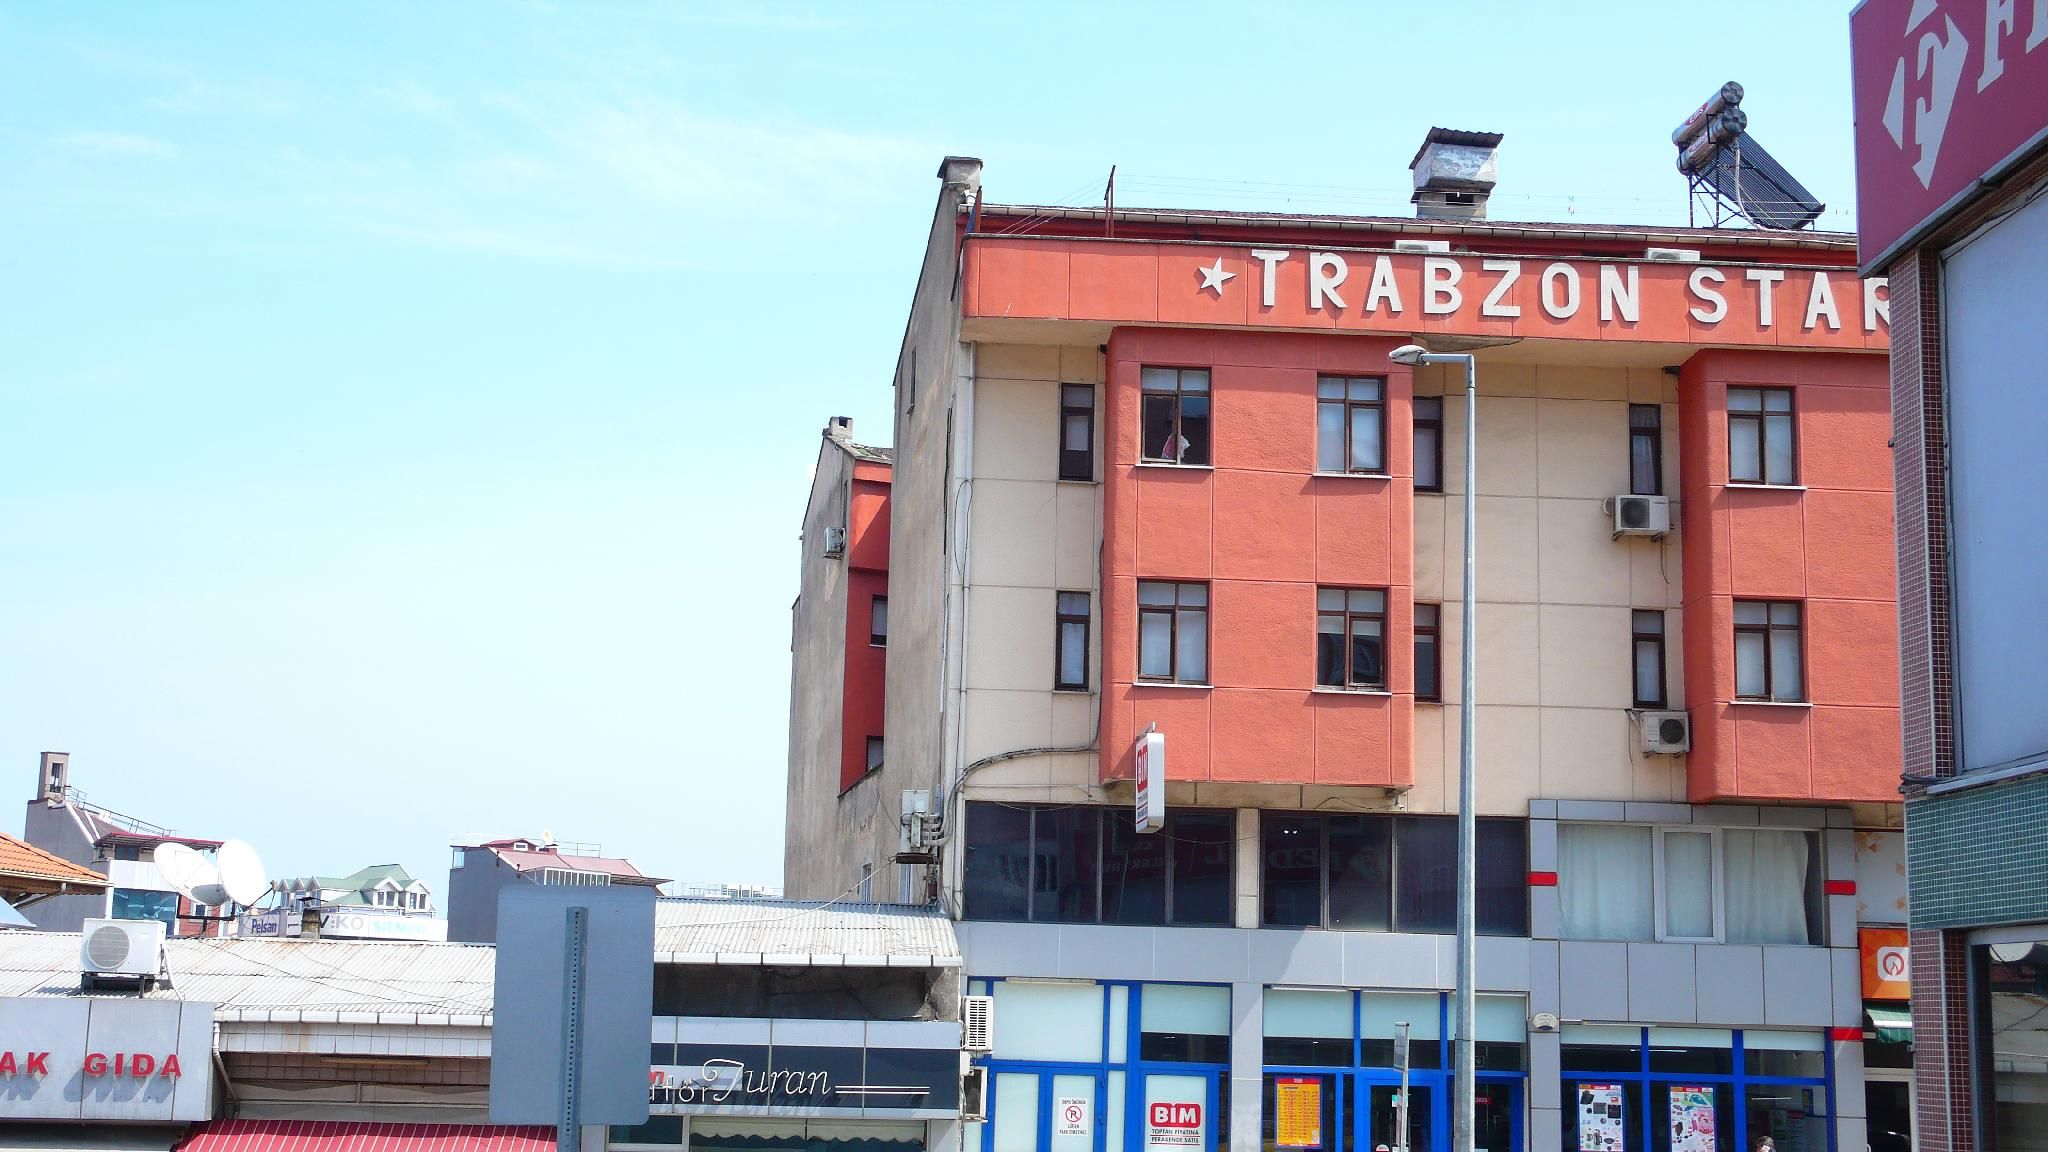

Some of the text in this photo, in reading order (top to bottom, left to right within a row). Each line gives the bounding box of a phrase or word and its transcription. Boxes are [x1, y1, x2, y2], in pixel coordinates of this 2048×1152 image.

[1252, 249, 1889, 331] TRABZON STAR
[251, 917, 277, 935] Pelsan
[0, 1051, 182, 1077] AK GIDA
[702, 1058, 831, 1101] Turan
